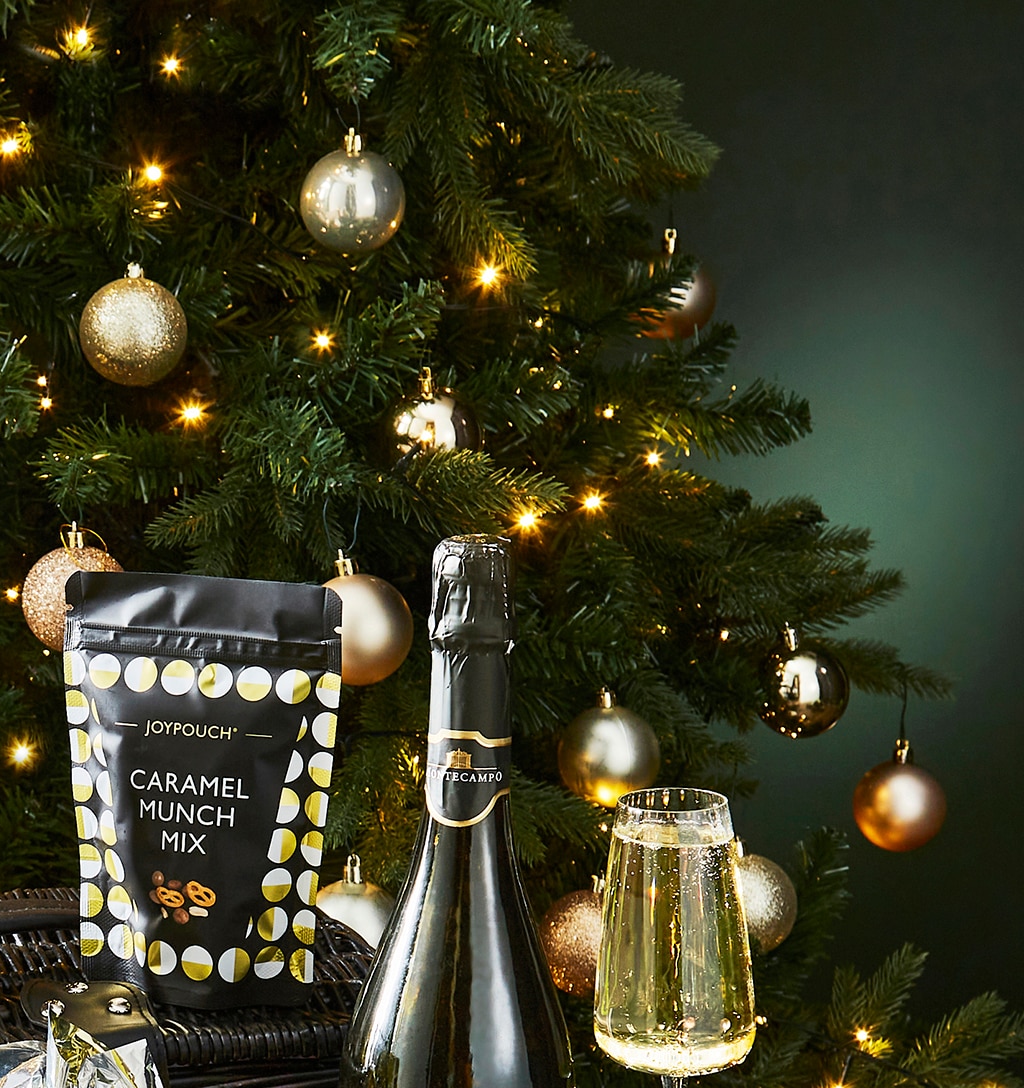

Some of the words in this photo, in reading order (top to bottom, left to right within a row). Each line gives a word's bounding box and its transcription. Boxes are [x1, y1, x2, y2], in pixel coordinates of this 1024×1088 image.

[130, 768, 249, 800] CARAMEL
[139, 798, 235, 828] MUNCH
[161, 830, 207, 856] MIX
